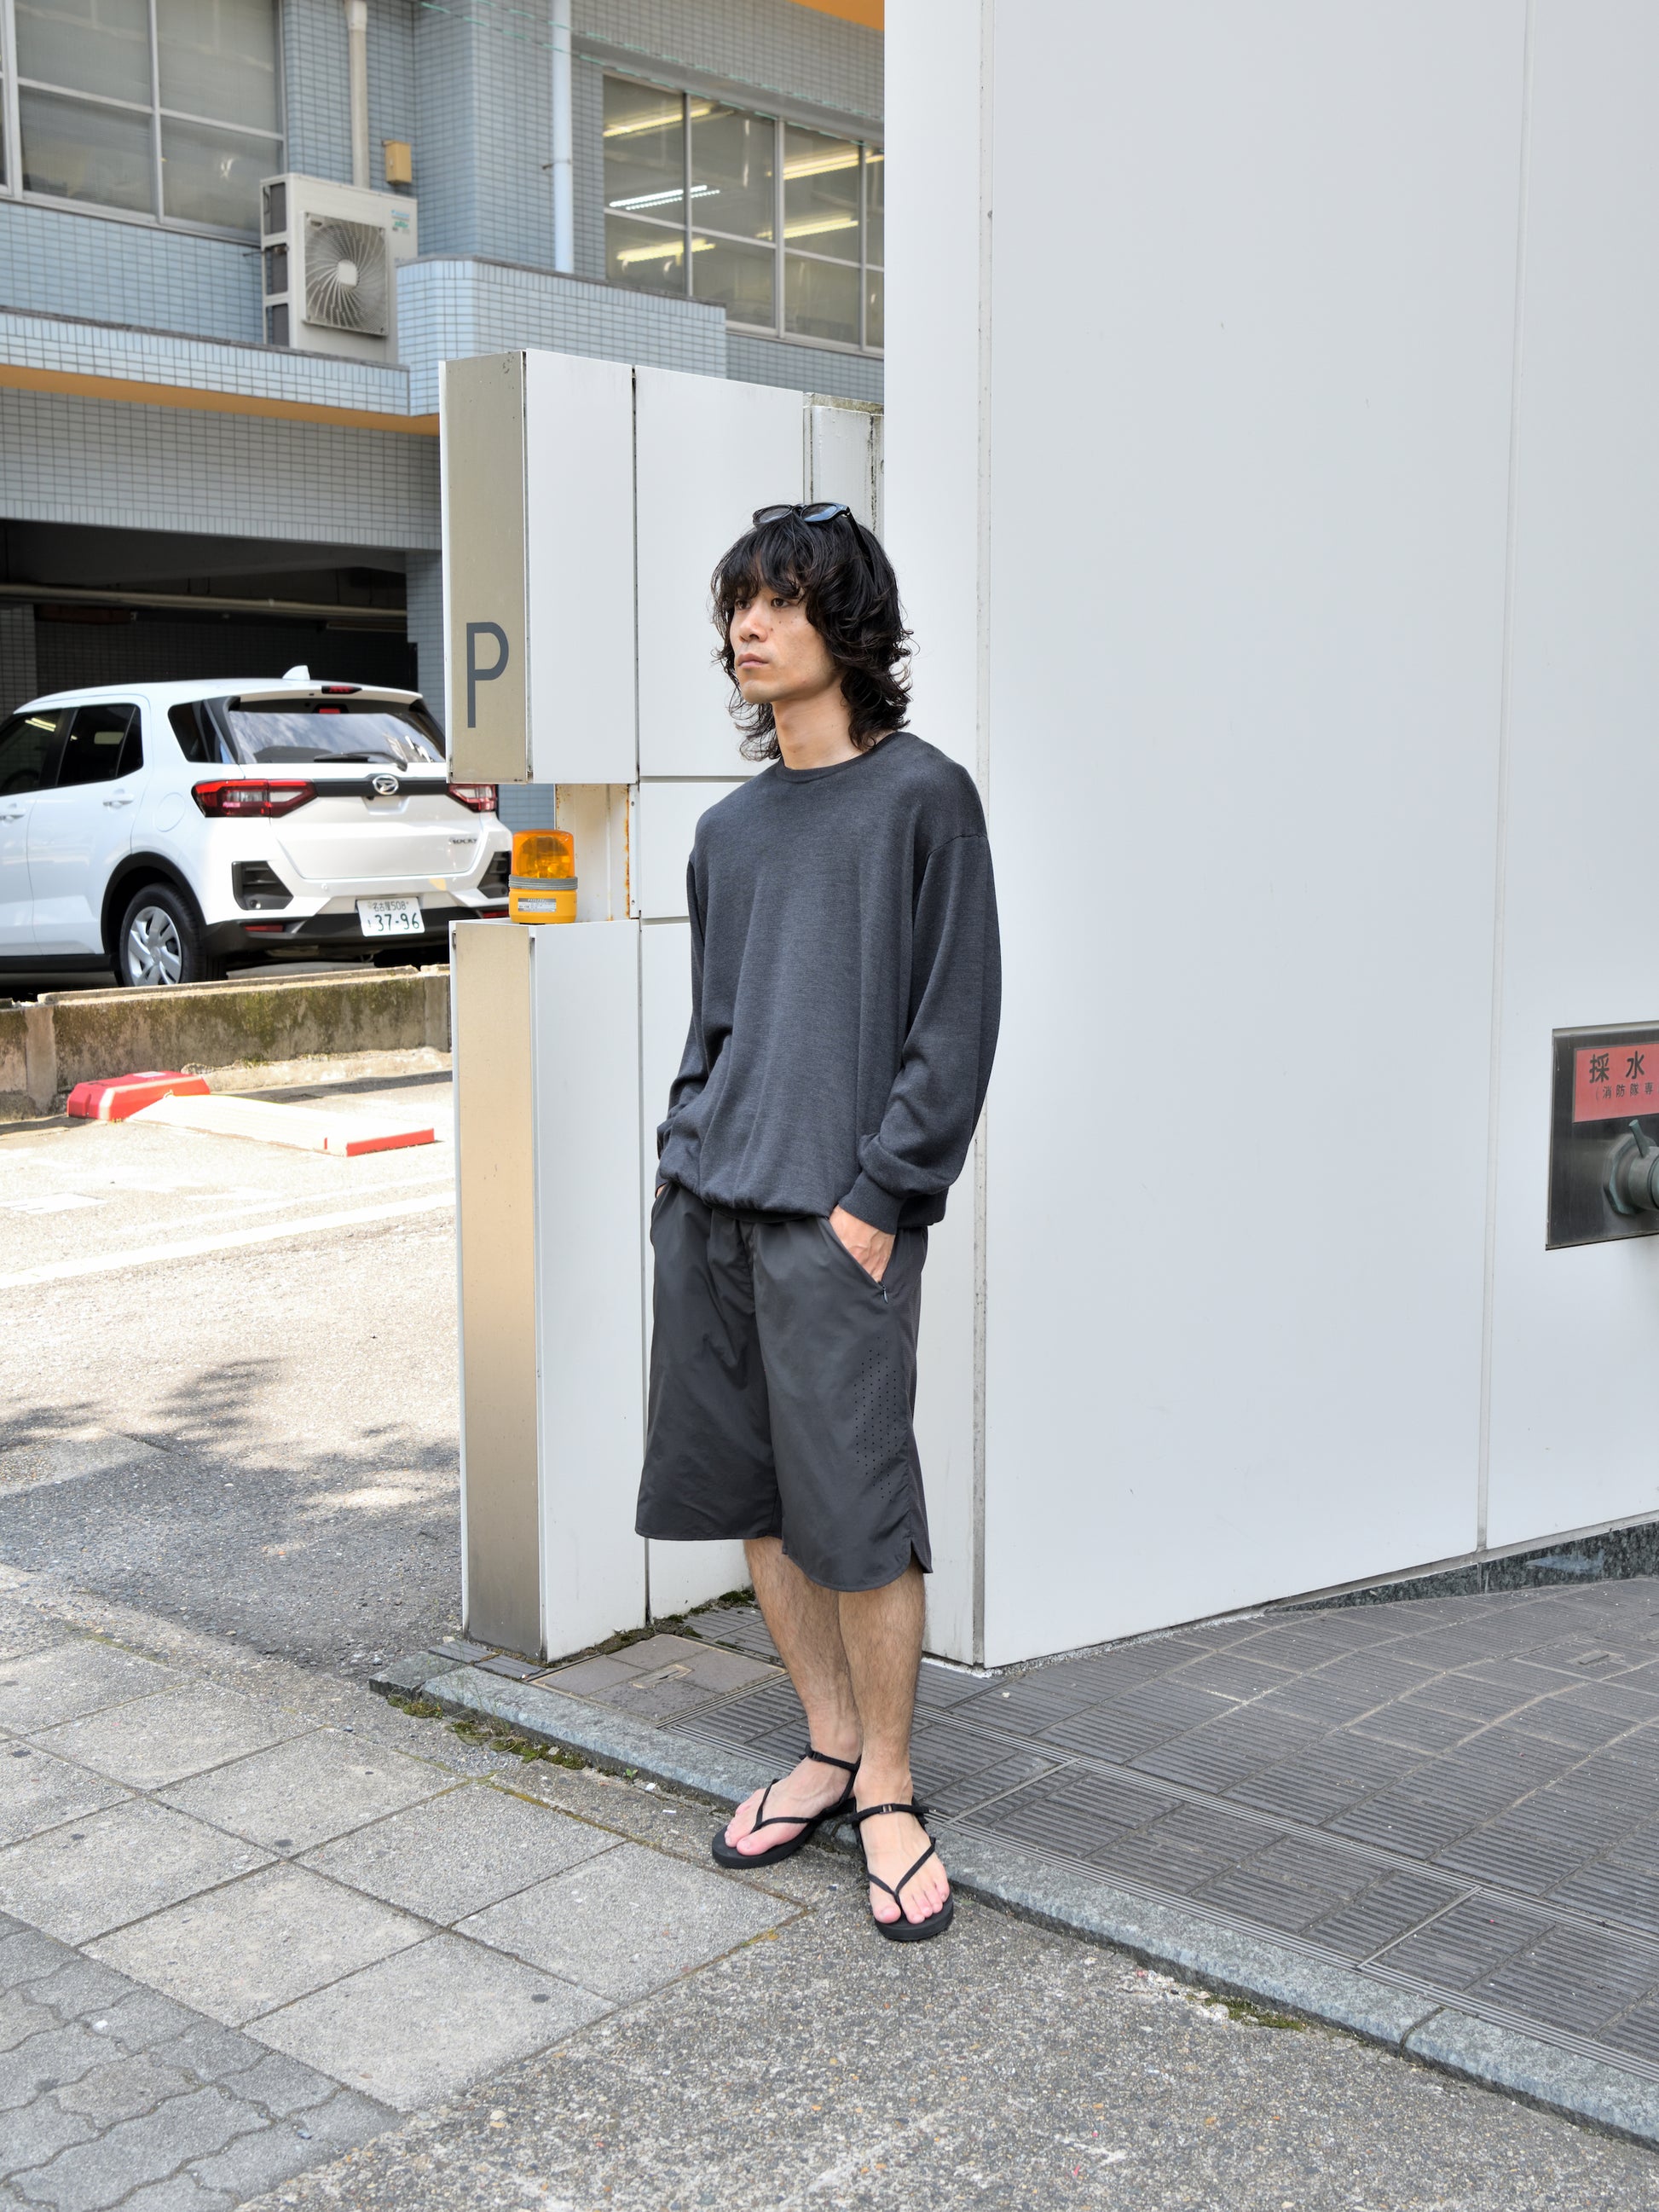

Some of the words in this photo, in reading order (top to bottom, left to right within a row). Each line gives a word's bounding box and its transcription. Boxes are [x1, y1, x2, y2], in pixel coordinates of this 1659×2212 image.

[466, 622, 509, 728] P
[374, 912, 419, 932] 37-96
[1589, 1050, 1645, 1084] 採水
[1595, 1081, 1659, 1102] (消防隊専
